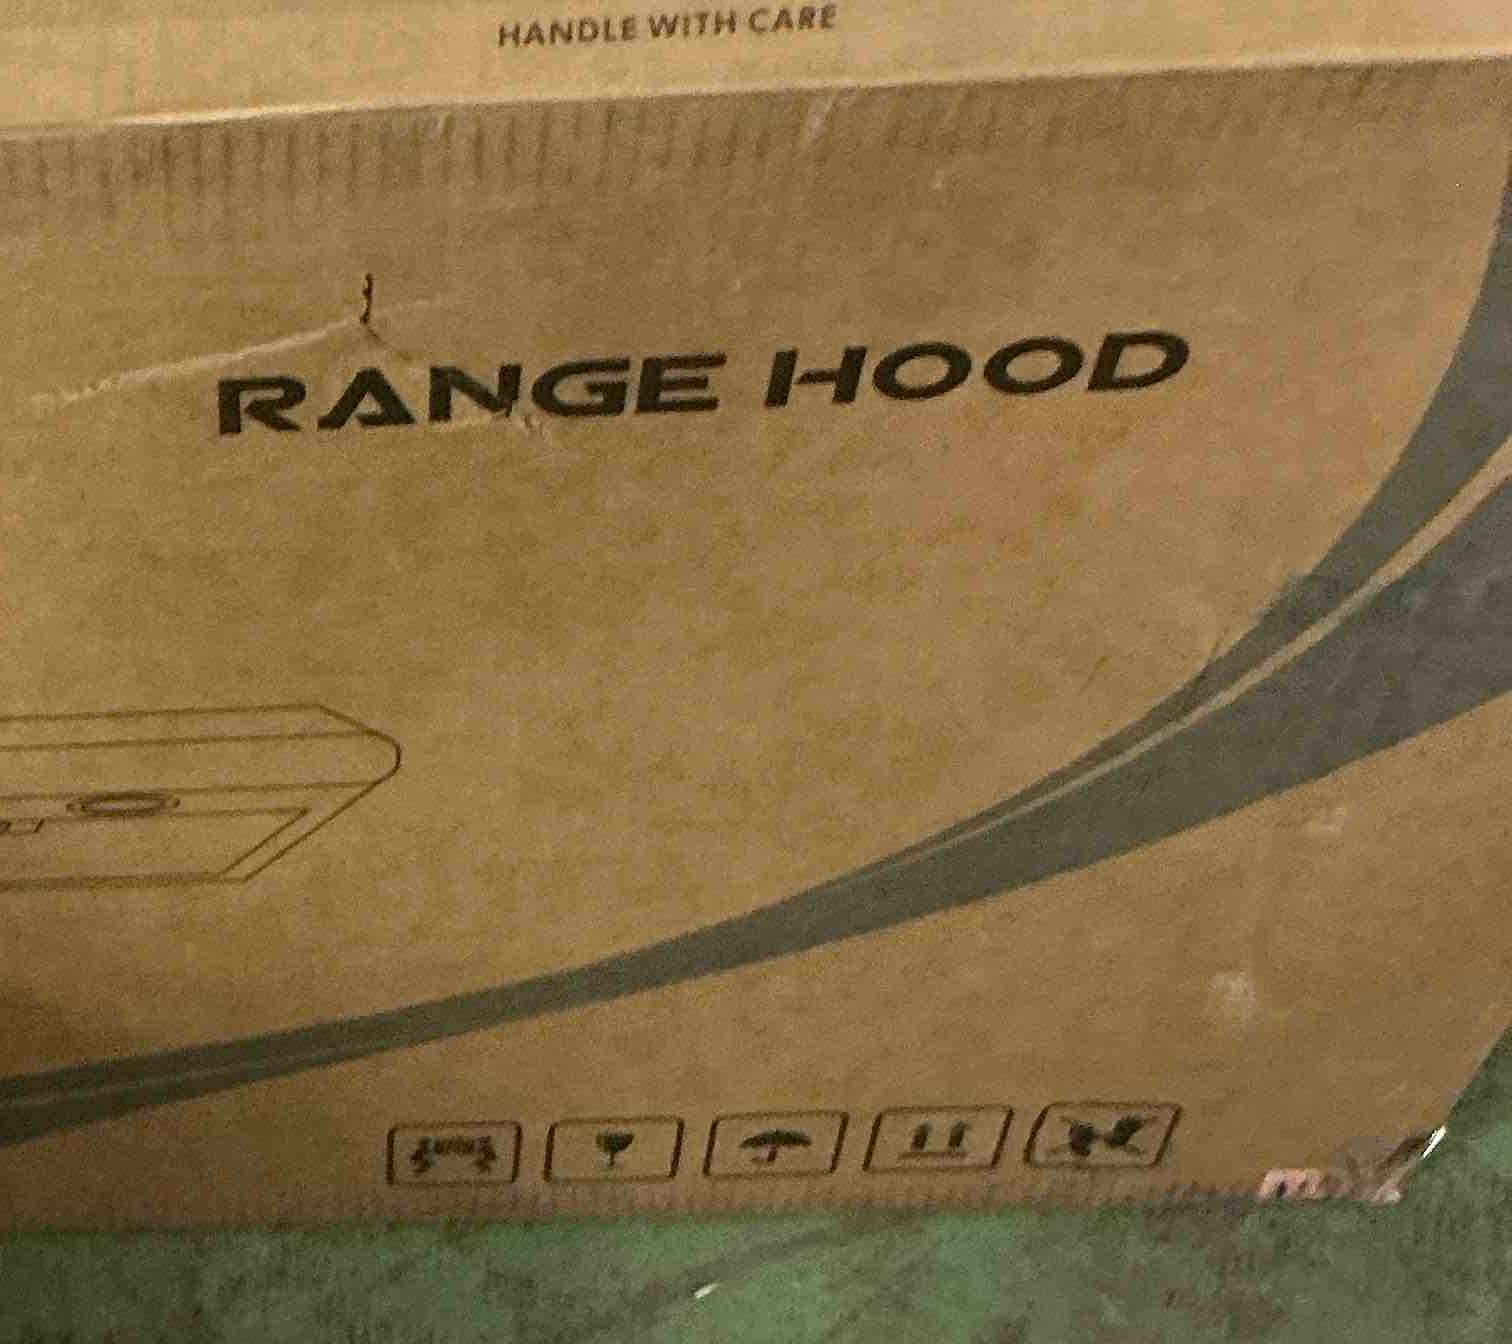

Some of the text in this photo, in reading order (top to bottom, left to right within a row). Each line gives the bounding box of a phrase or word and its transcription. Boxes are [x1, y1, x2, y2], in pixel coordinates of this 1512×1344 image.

[497, 3, 838, 48] HANDLE WITH CARE
[216, 330, 1191, 437] RANGE HOOD
